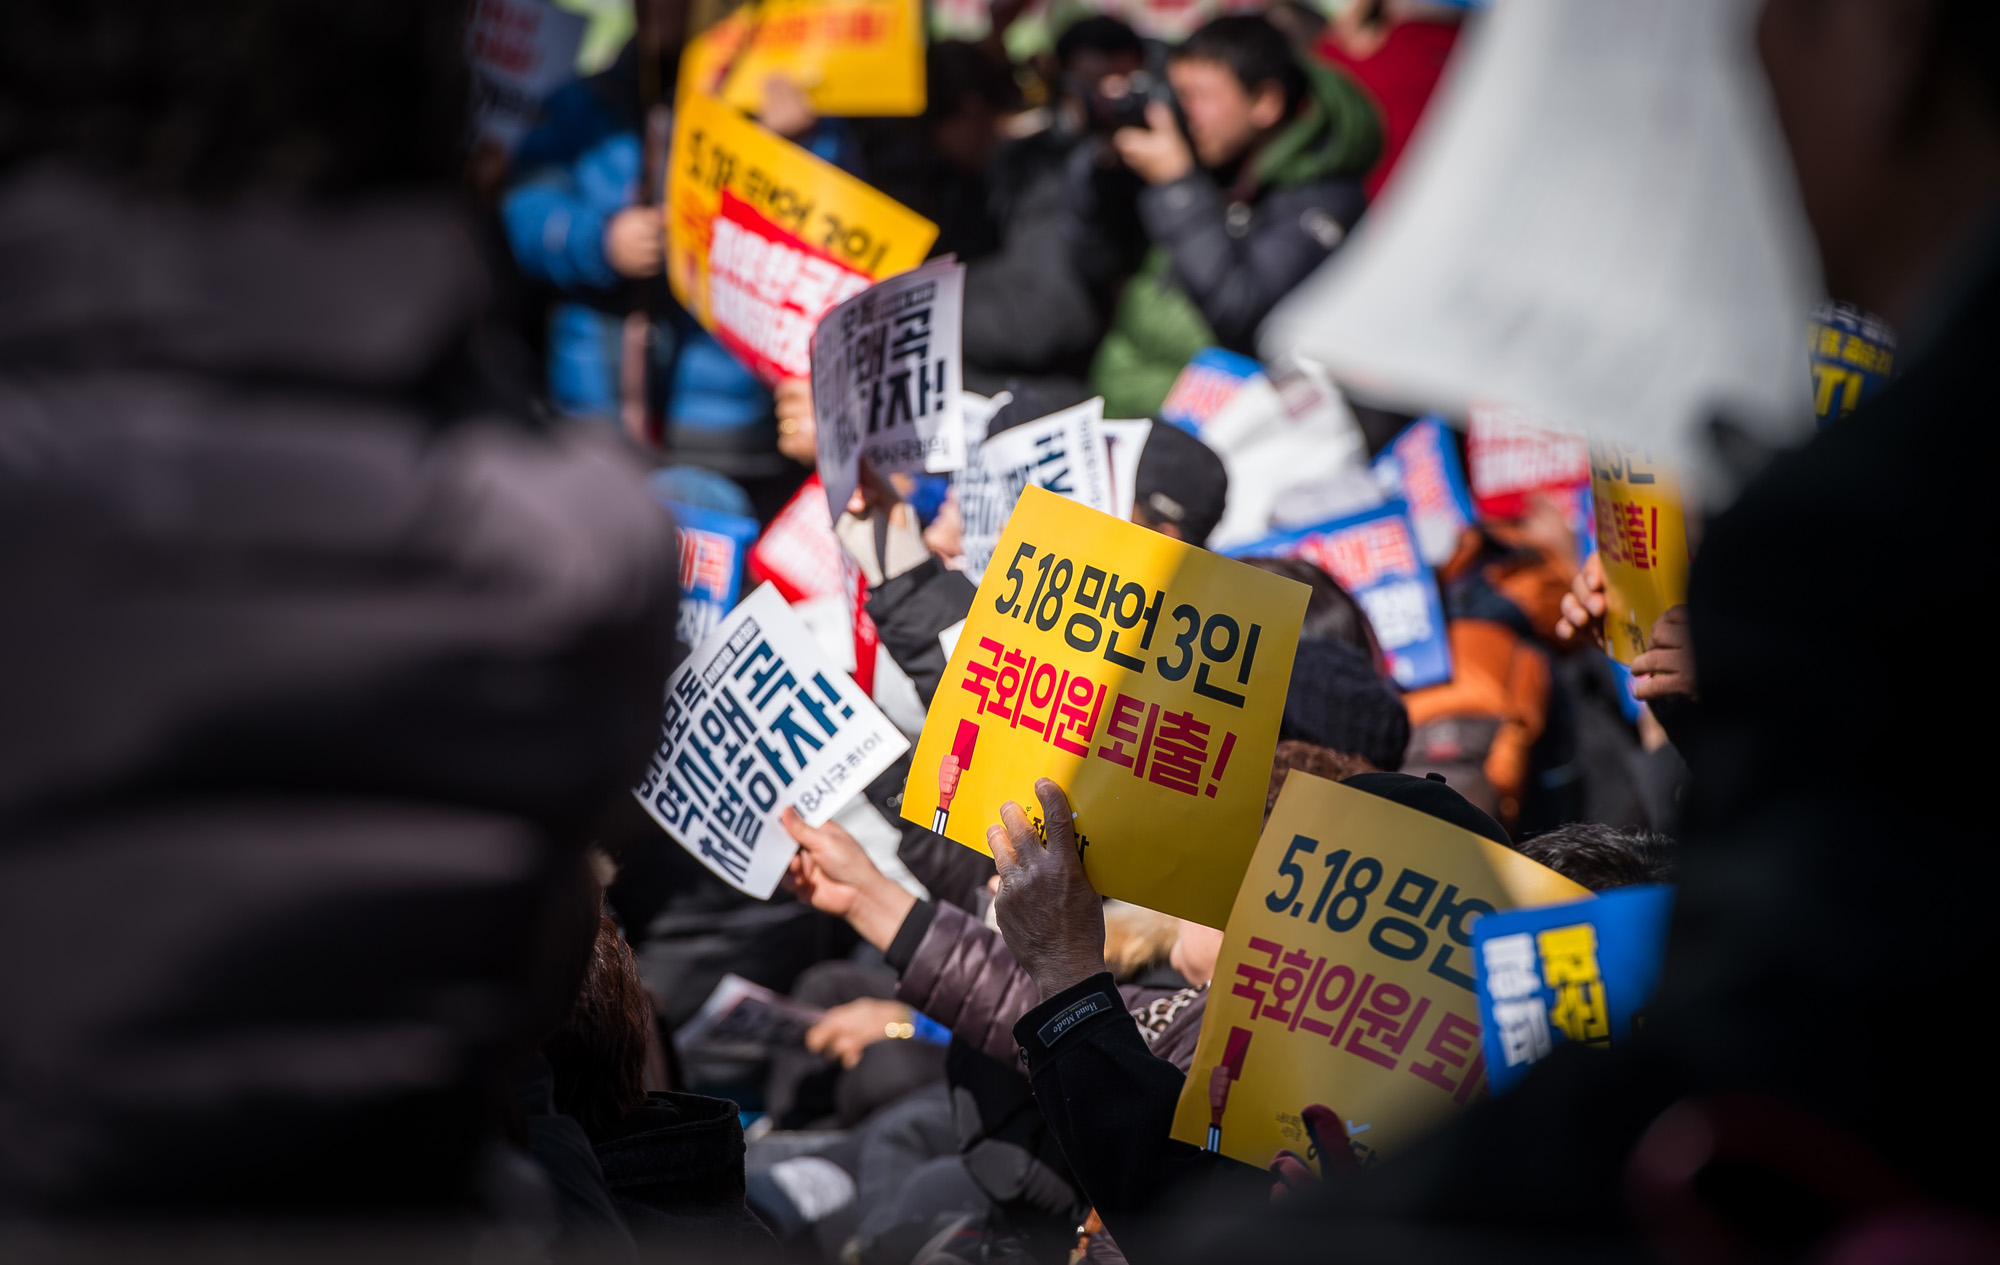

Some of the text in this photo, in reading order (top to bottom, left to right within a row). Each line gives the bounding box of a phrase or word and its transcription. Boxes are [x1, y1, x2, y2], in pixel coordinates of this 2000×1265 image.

[995, 542, 1074, 632] 5.18
[1064, 565, 1166, 673] 망언
[1157, 604, 1262, 709] 3인
[655, 639, 797, 835] 역사왜곡
[699, 671, 854, 884] 처벌하자!
[961, 636, 1238, 799] 국회의원 퇴출!
[1265, 834, 1383, 933] 5.18
[1053, 1016, 1076, 1033] Made
[1075, 1002, 1098, 1019] Hand
[1231, 936, 1431, 1071] 국회의원
